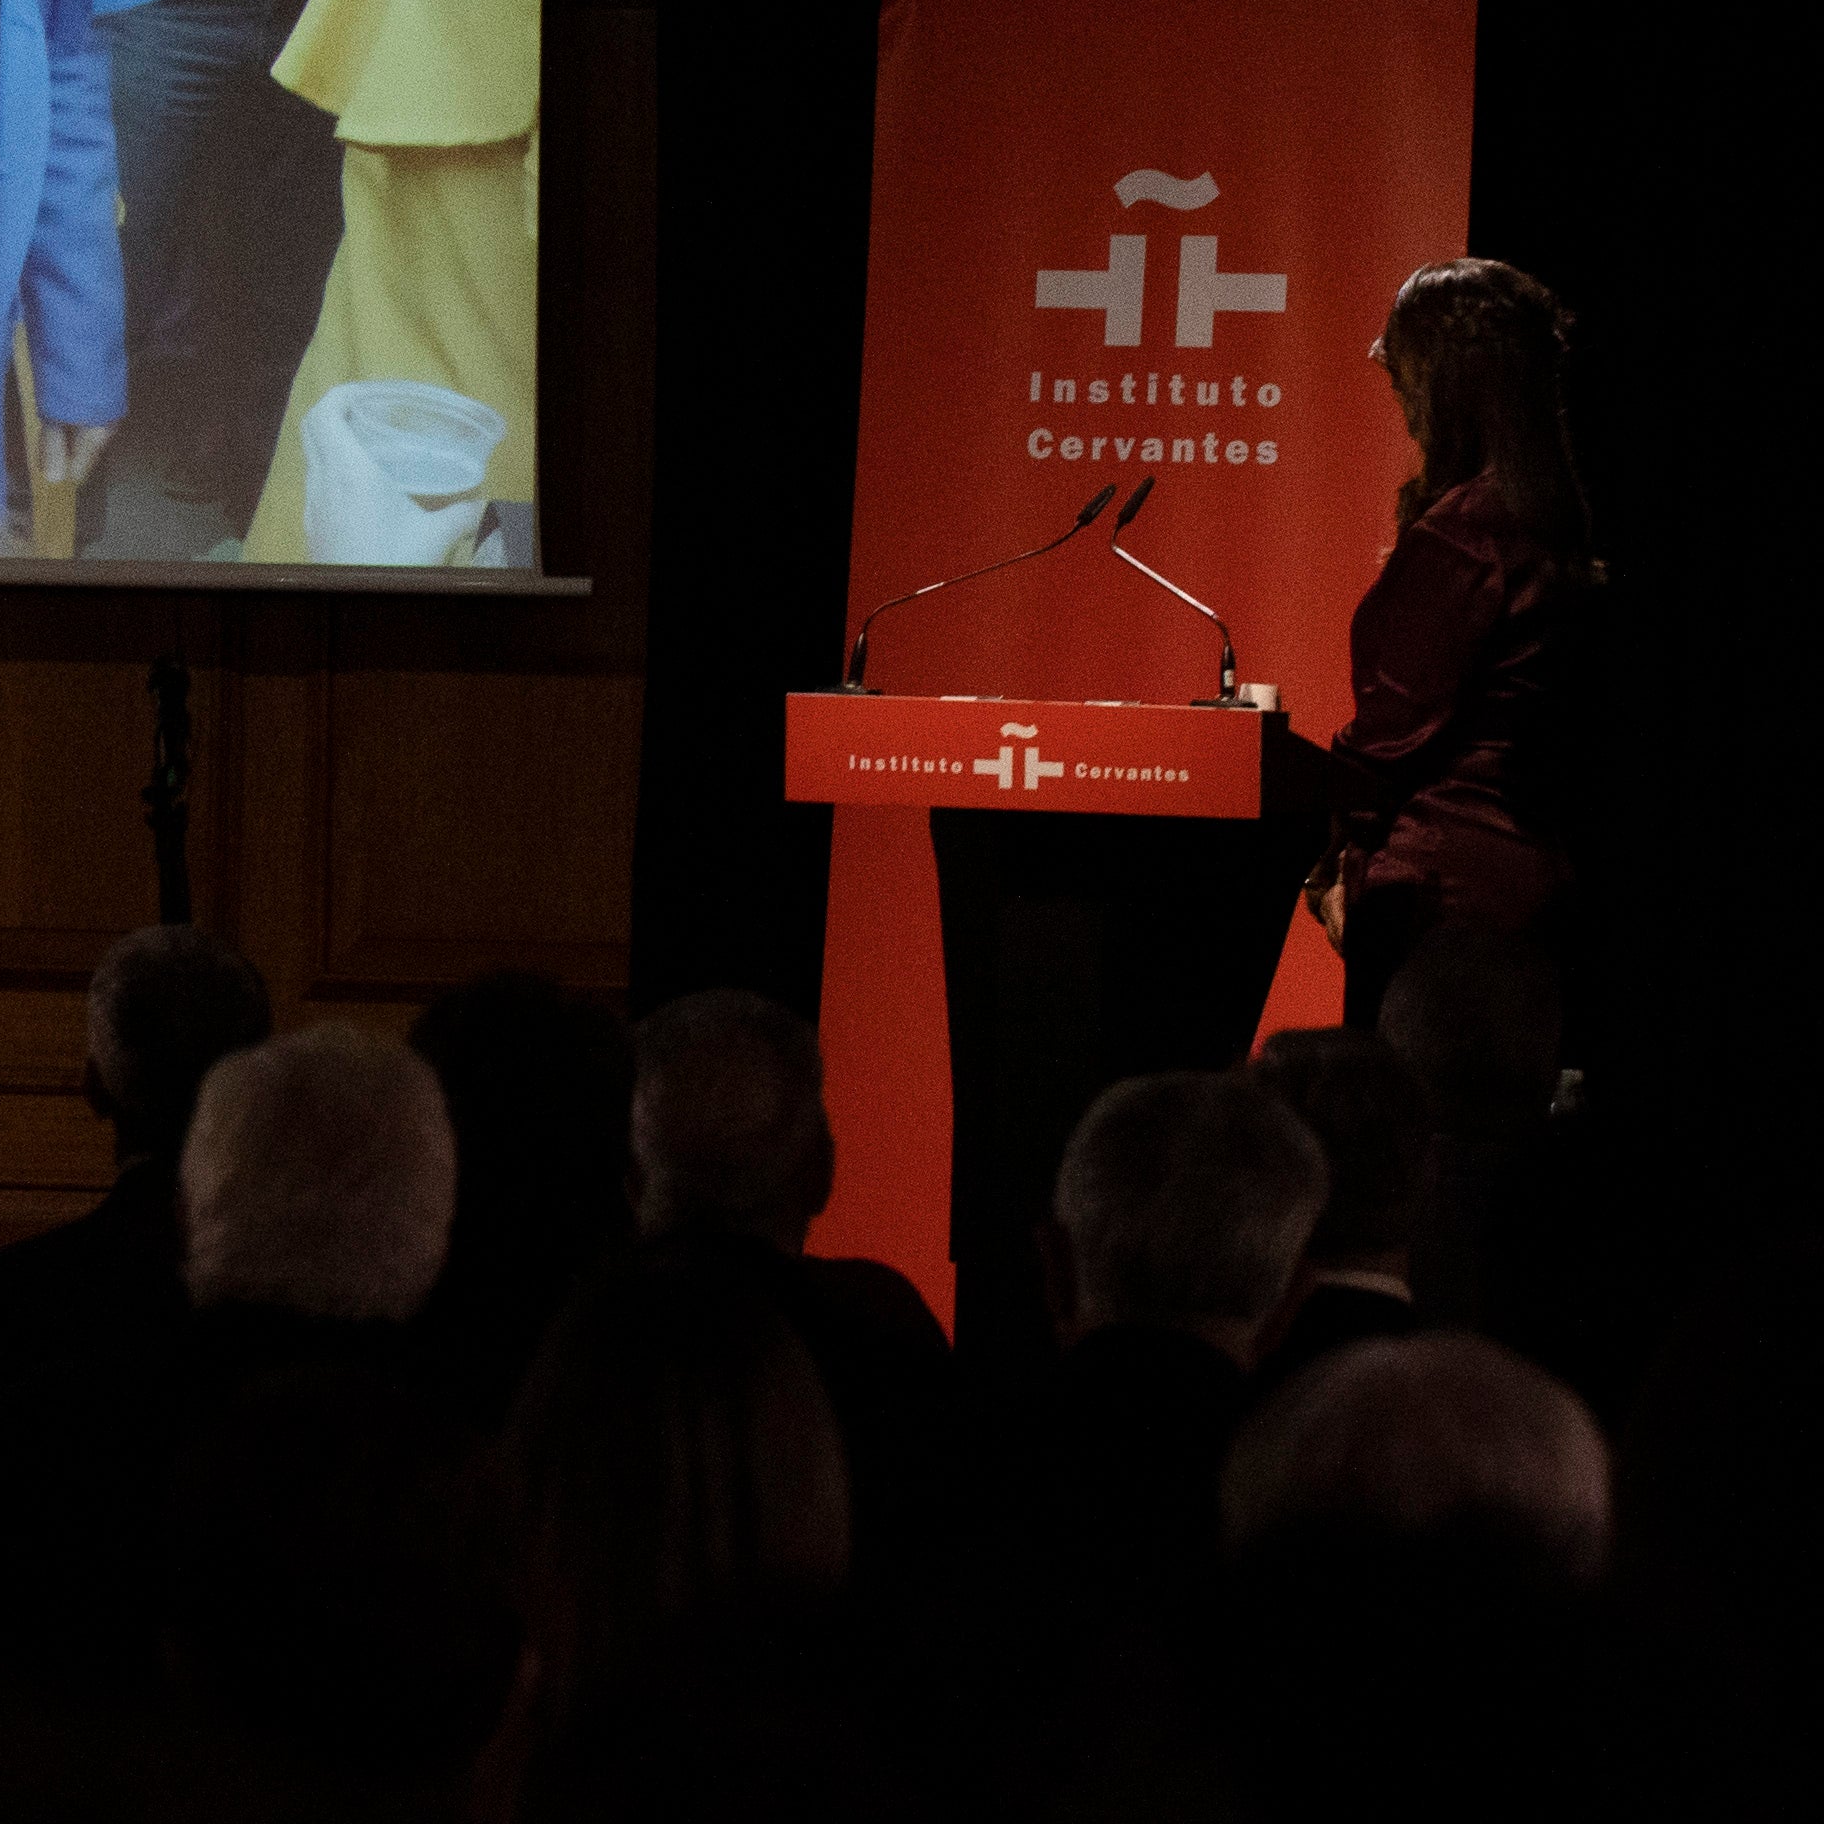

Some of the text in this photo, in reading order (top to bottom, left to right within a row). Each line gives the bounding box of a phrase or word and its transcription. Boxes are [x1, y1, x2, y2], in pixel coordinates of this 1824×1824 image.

[1029, 371, 1283, 407] Instituto
[1026, 427, 1279, 465] Cervantes
[849, 754, 1190, 782] Instituto Cervantes
